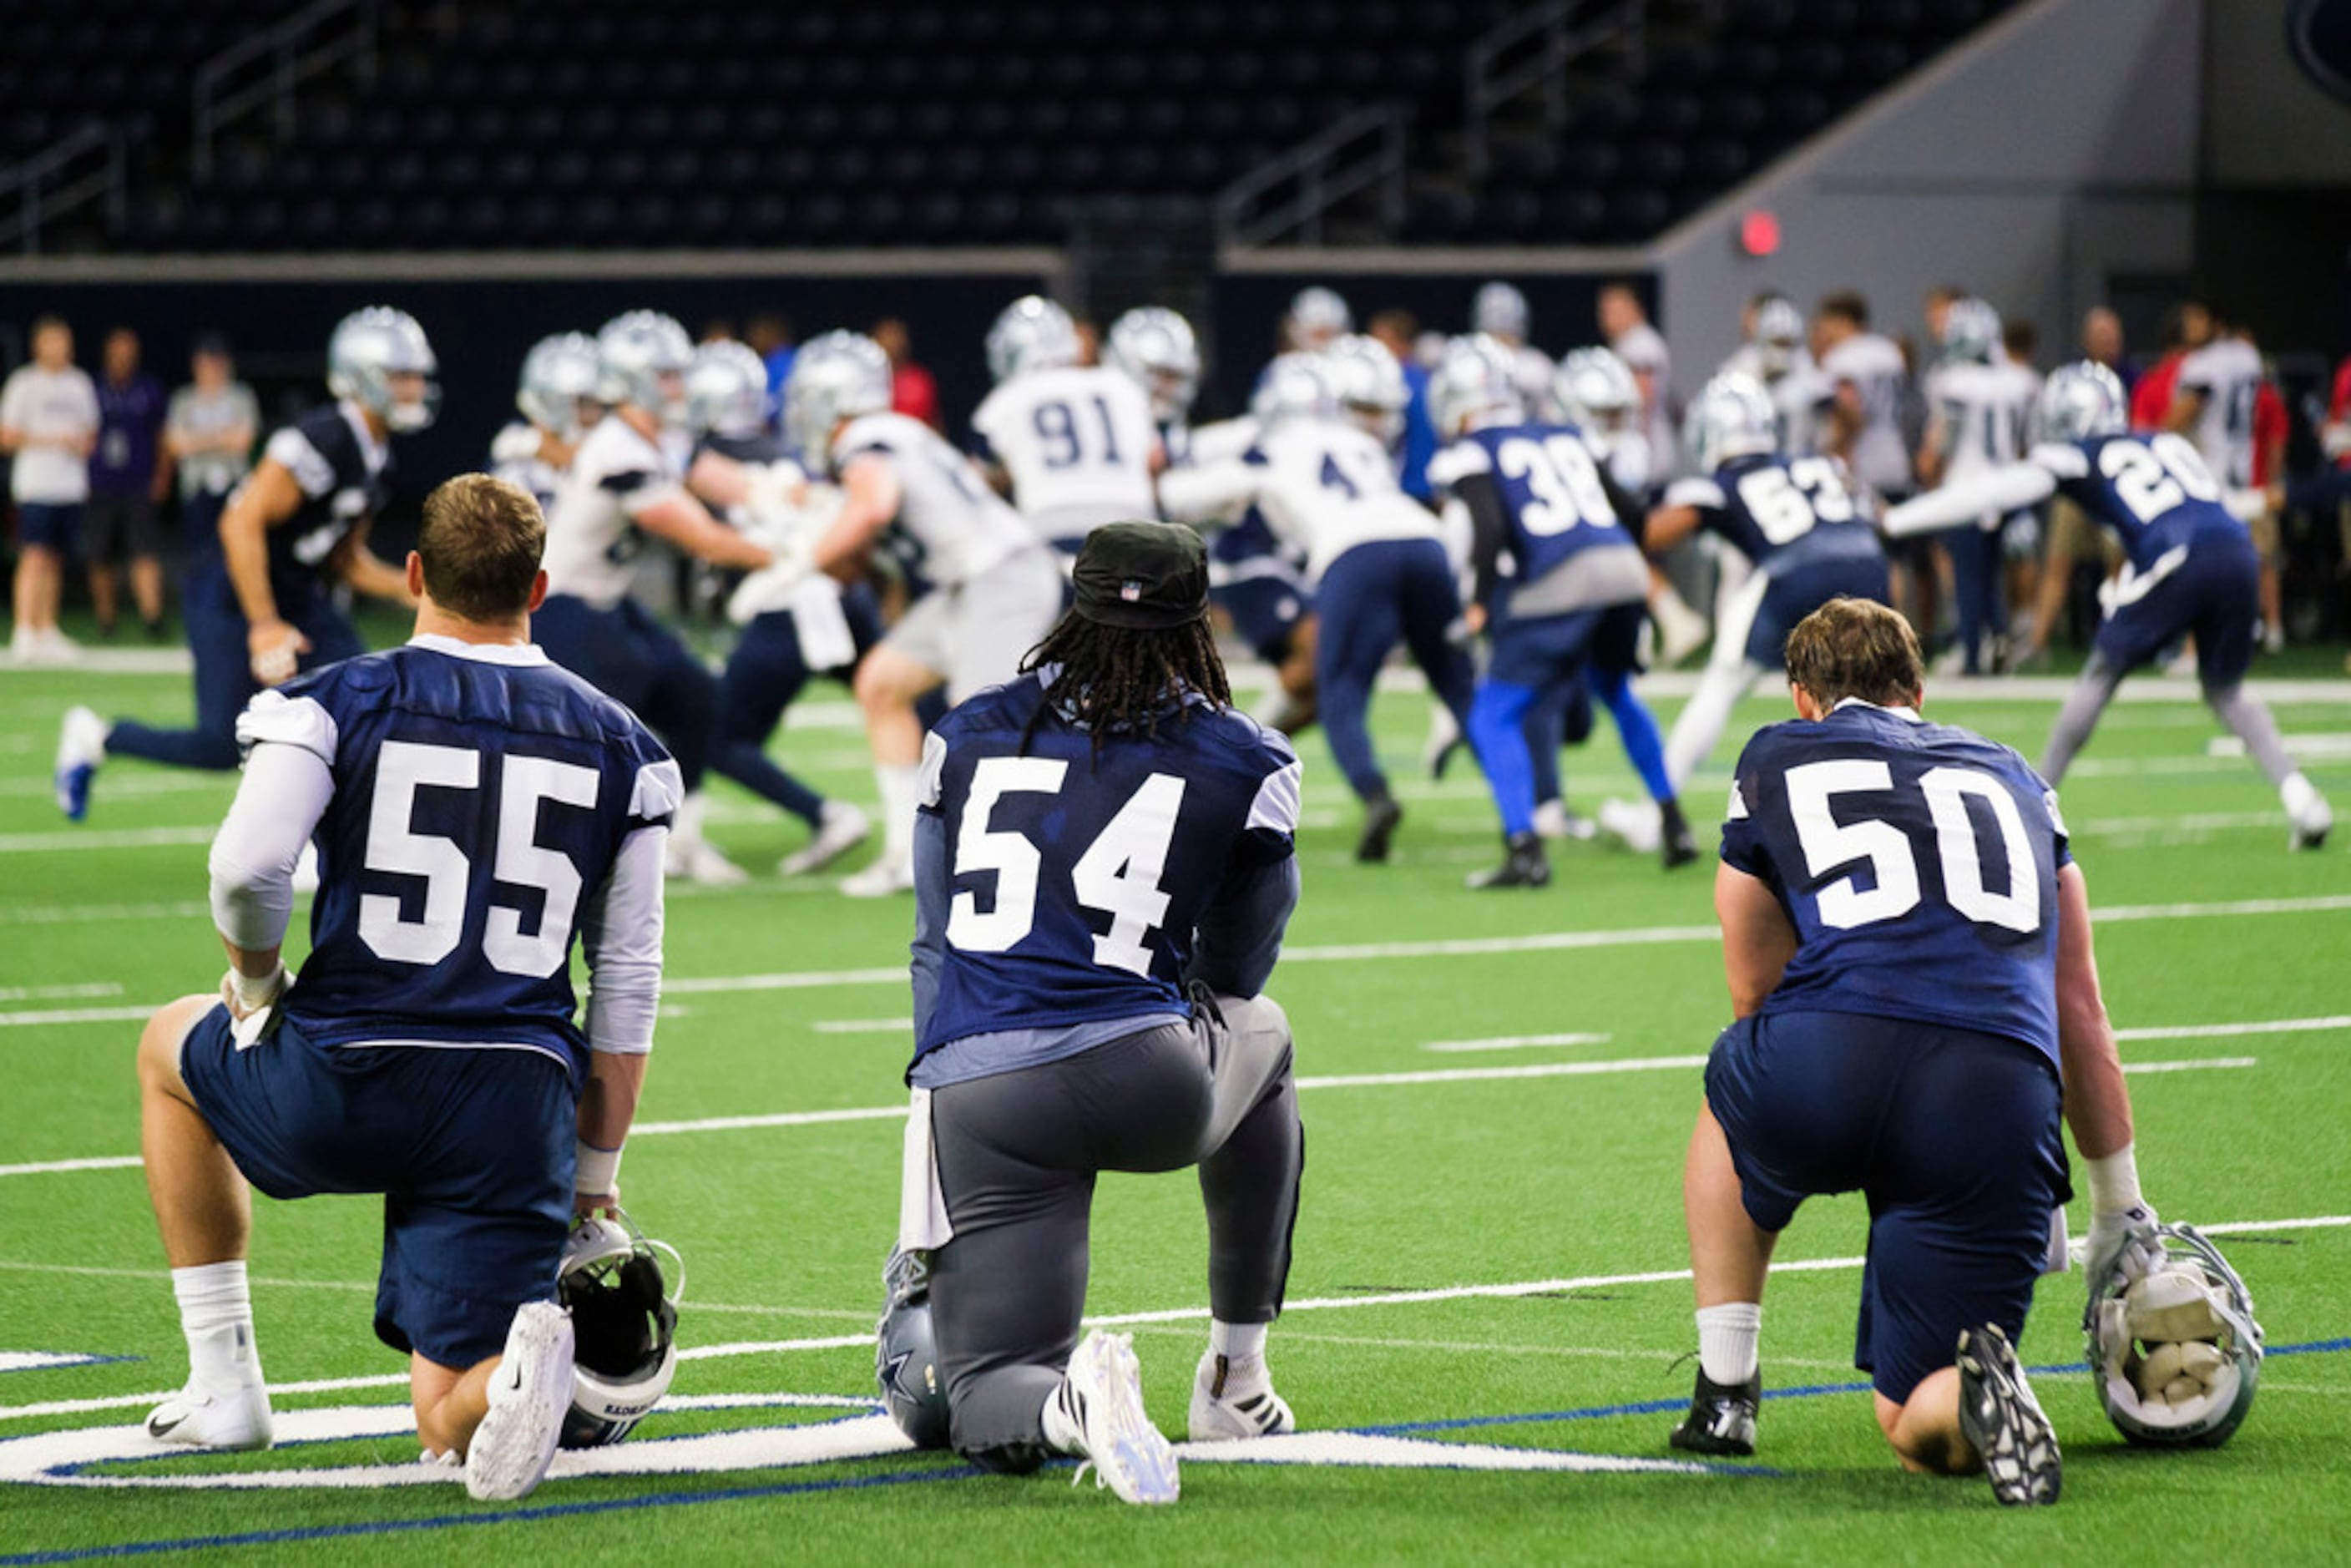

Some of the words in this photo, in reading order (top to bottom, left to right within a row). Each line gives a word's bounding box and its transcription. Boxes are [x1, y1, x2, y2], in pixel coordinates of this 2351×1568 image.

[1032, 396, 1120, 471] 91
[2097, 432, 2220, 520] 20
[357, 740, 600, 979] 55
[945, 756, 1186, 979] 54
[1784, 759, 2040, 933] 50
